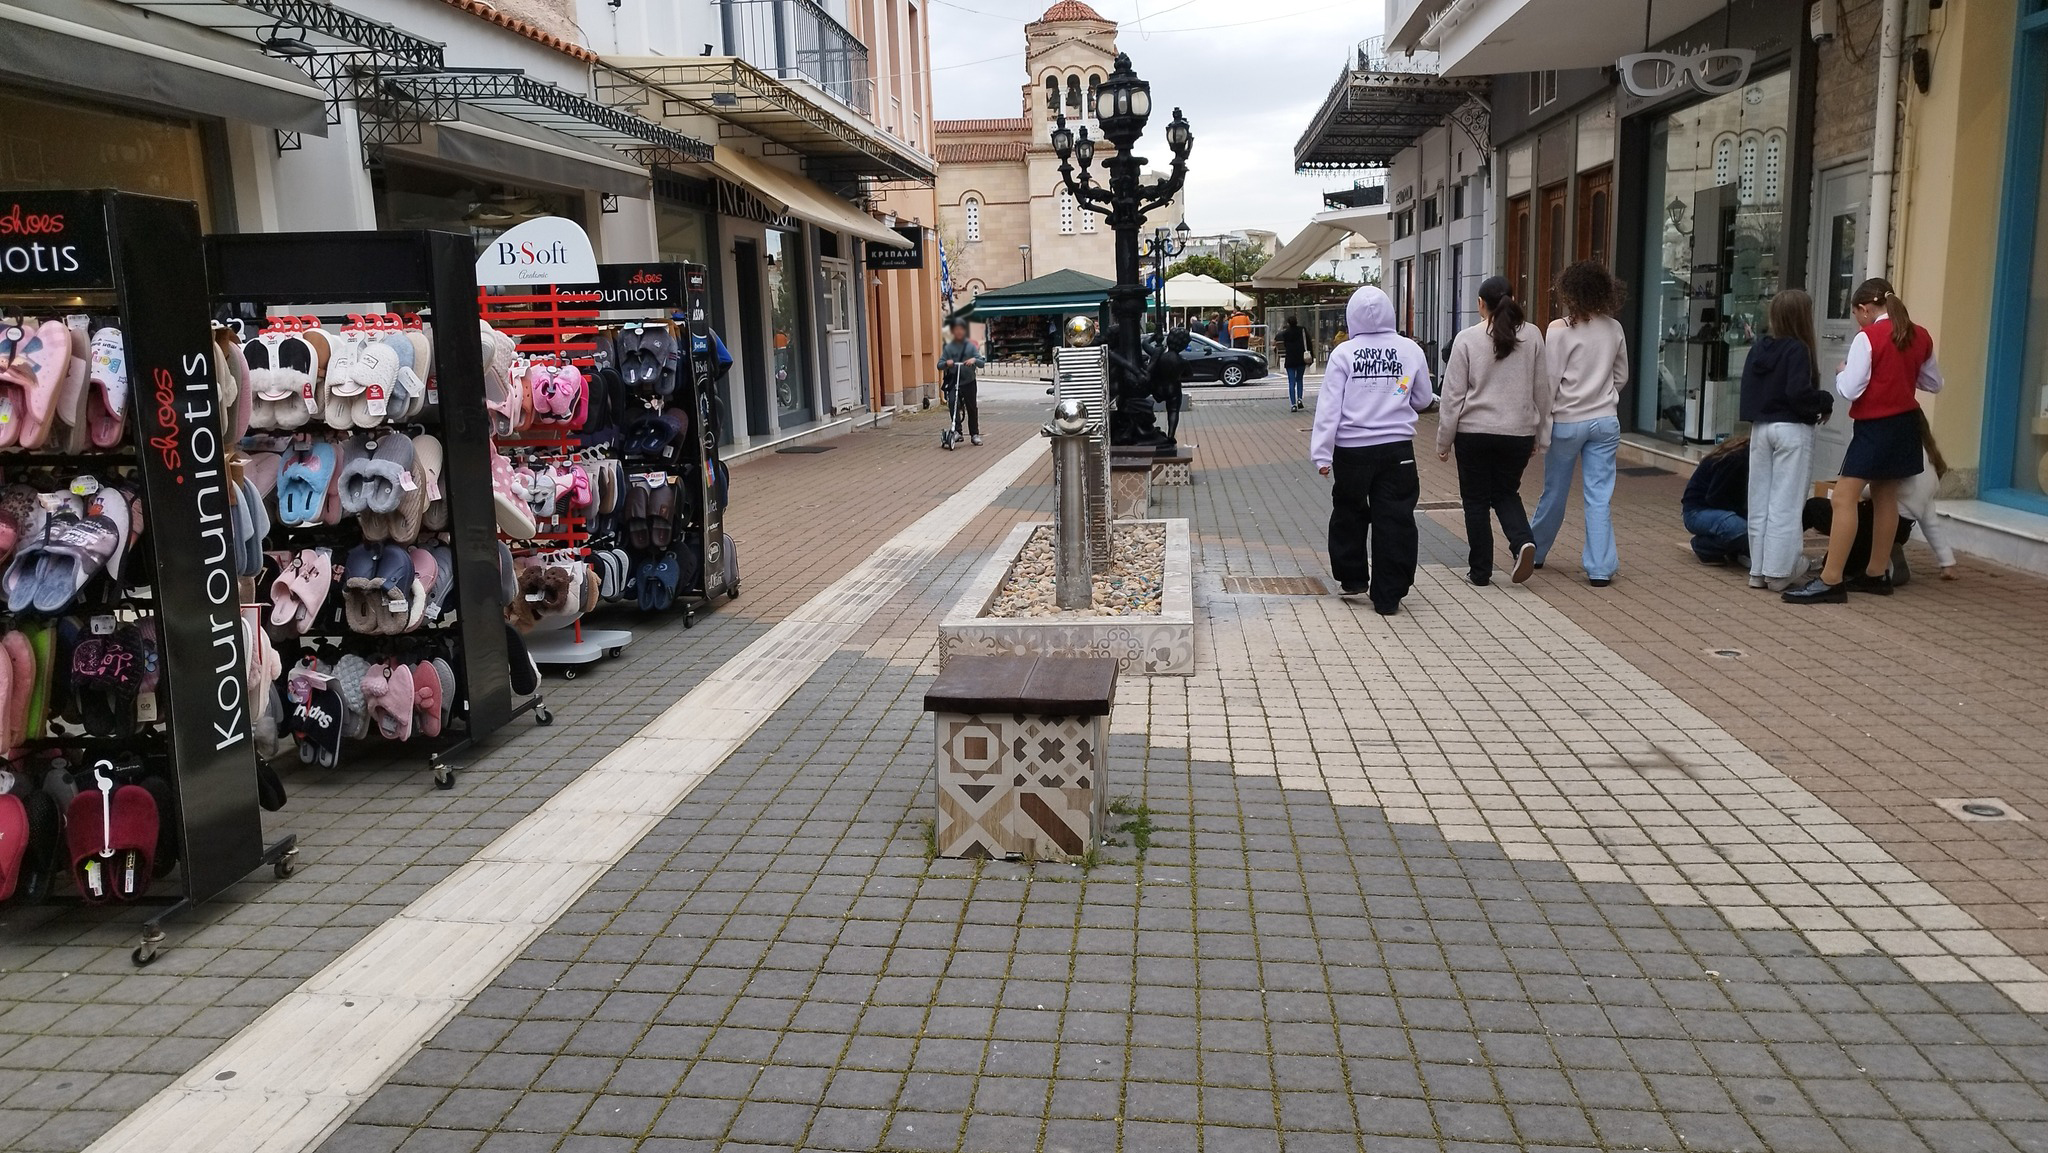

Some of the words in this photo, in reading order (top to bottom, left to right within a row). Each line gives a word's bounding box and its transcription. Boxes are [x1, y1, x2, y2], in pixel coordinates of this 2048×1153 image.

[497, 240, 569, 266] B-Soft
[1353, 347, 1382, 361] SORRY
[1385, 348, 1398, 361] OR
[1352, 359, 1403, 376] WHATEVER
